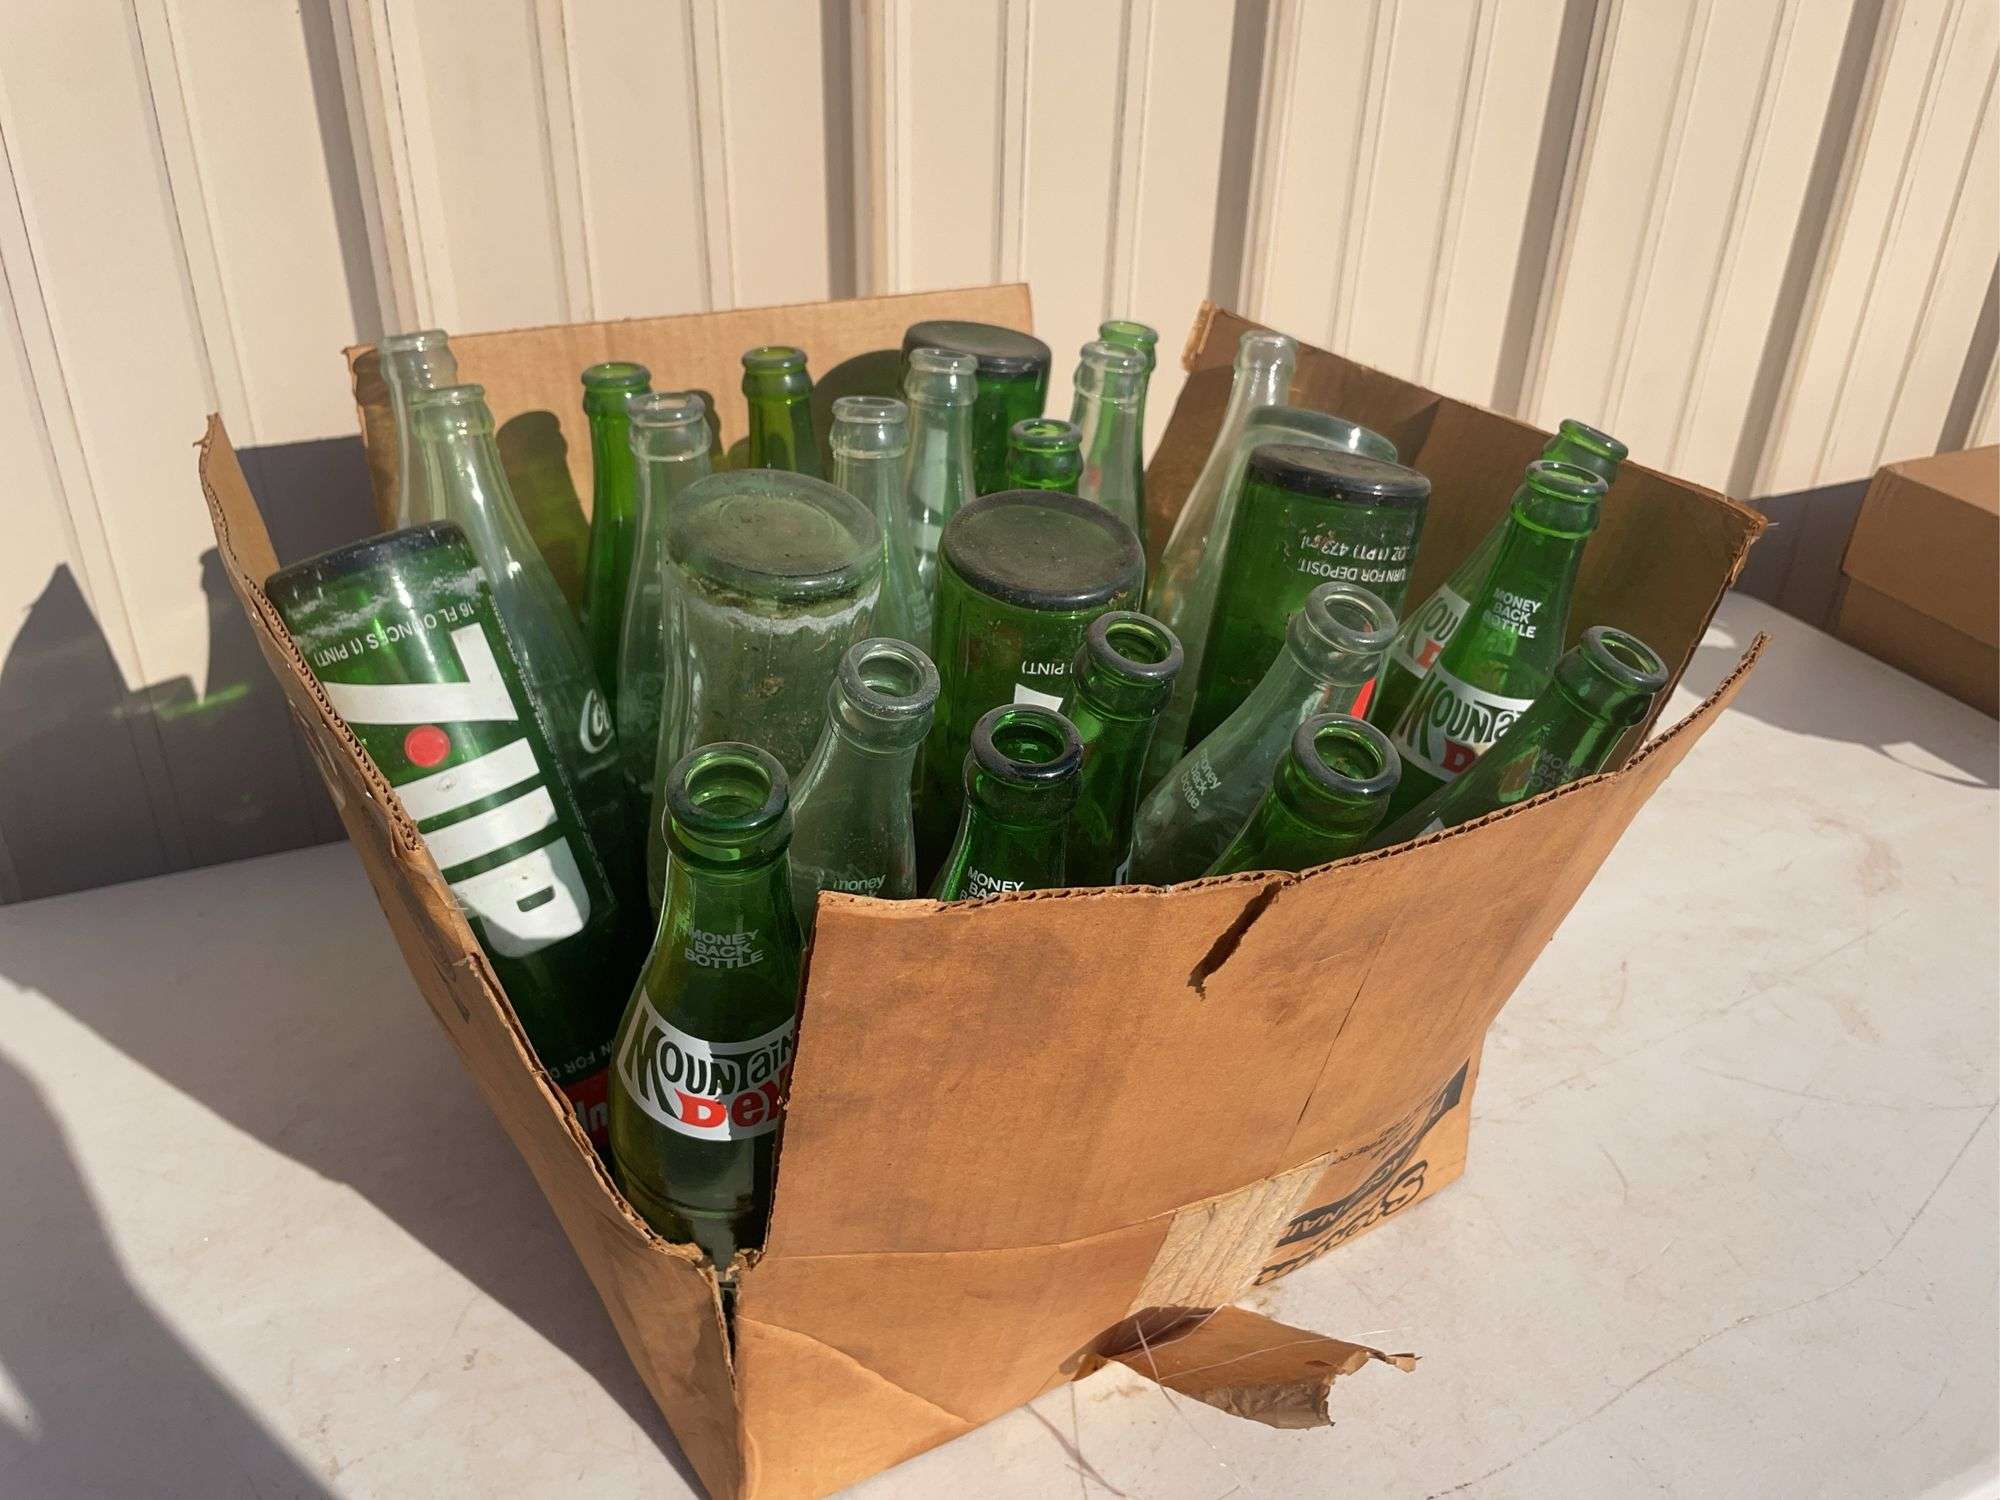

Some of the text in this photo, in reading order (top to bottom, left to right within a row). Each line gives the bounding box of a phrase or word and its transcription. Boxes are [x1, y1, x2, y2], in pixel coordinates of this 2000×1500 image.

[1360, 568, 1386, 583] FOR
[460, 602, 475, 617] 16
[1493, 588, 1542, 613] MONEY
[438, 607, 458, 623] FL
[1493, 602, 1531, 624] BACK
[366, 613, 437, 650] OUNCES
[1482, 609, 1537, 639] BOTTLE
[1021, 661, 1065, 675] PINT)
[968, 866, 1024, 893] MONEY
[689, 927, 759, 946] MONEY
[684, 947, 765, 969] BOTTLE
[695, 941, 752, 958] BACK
